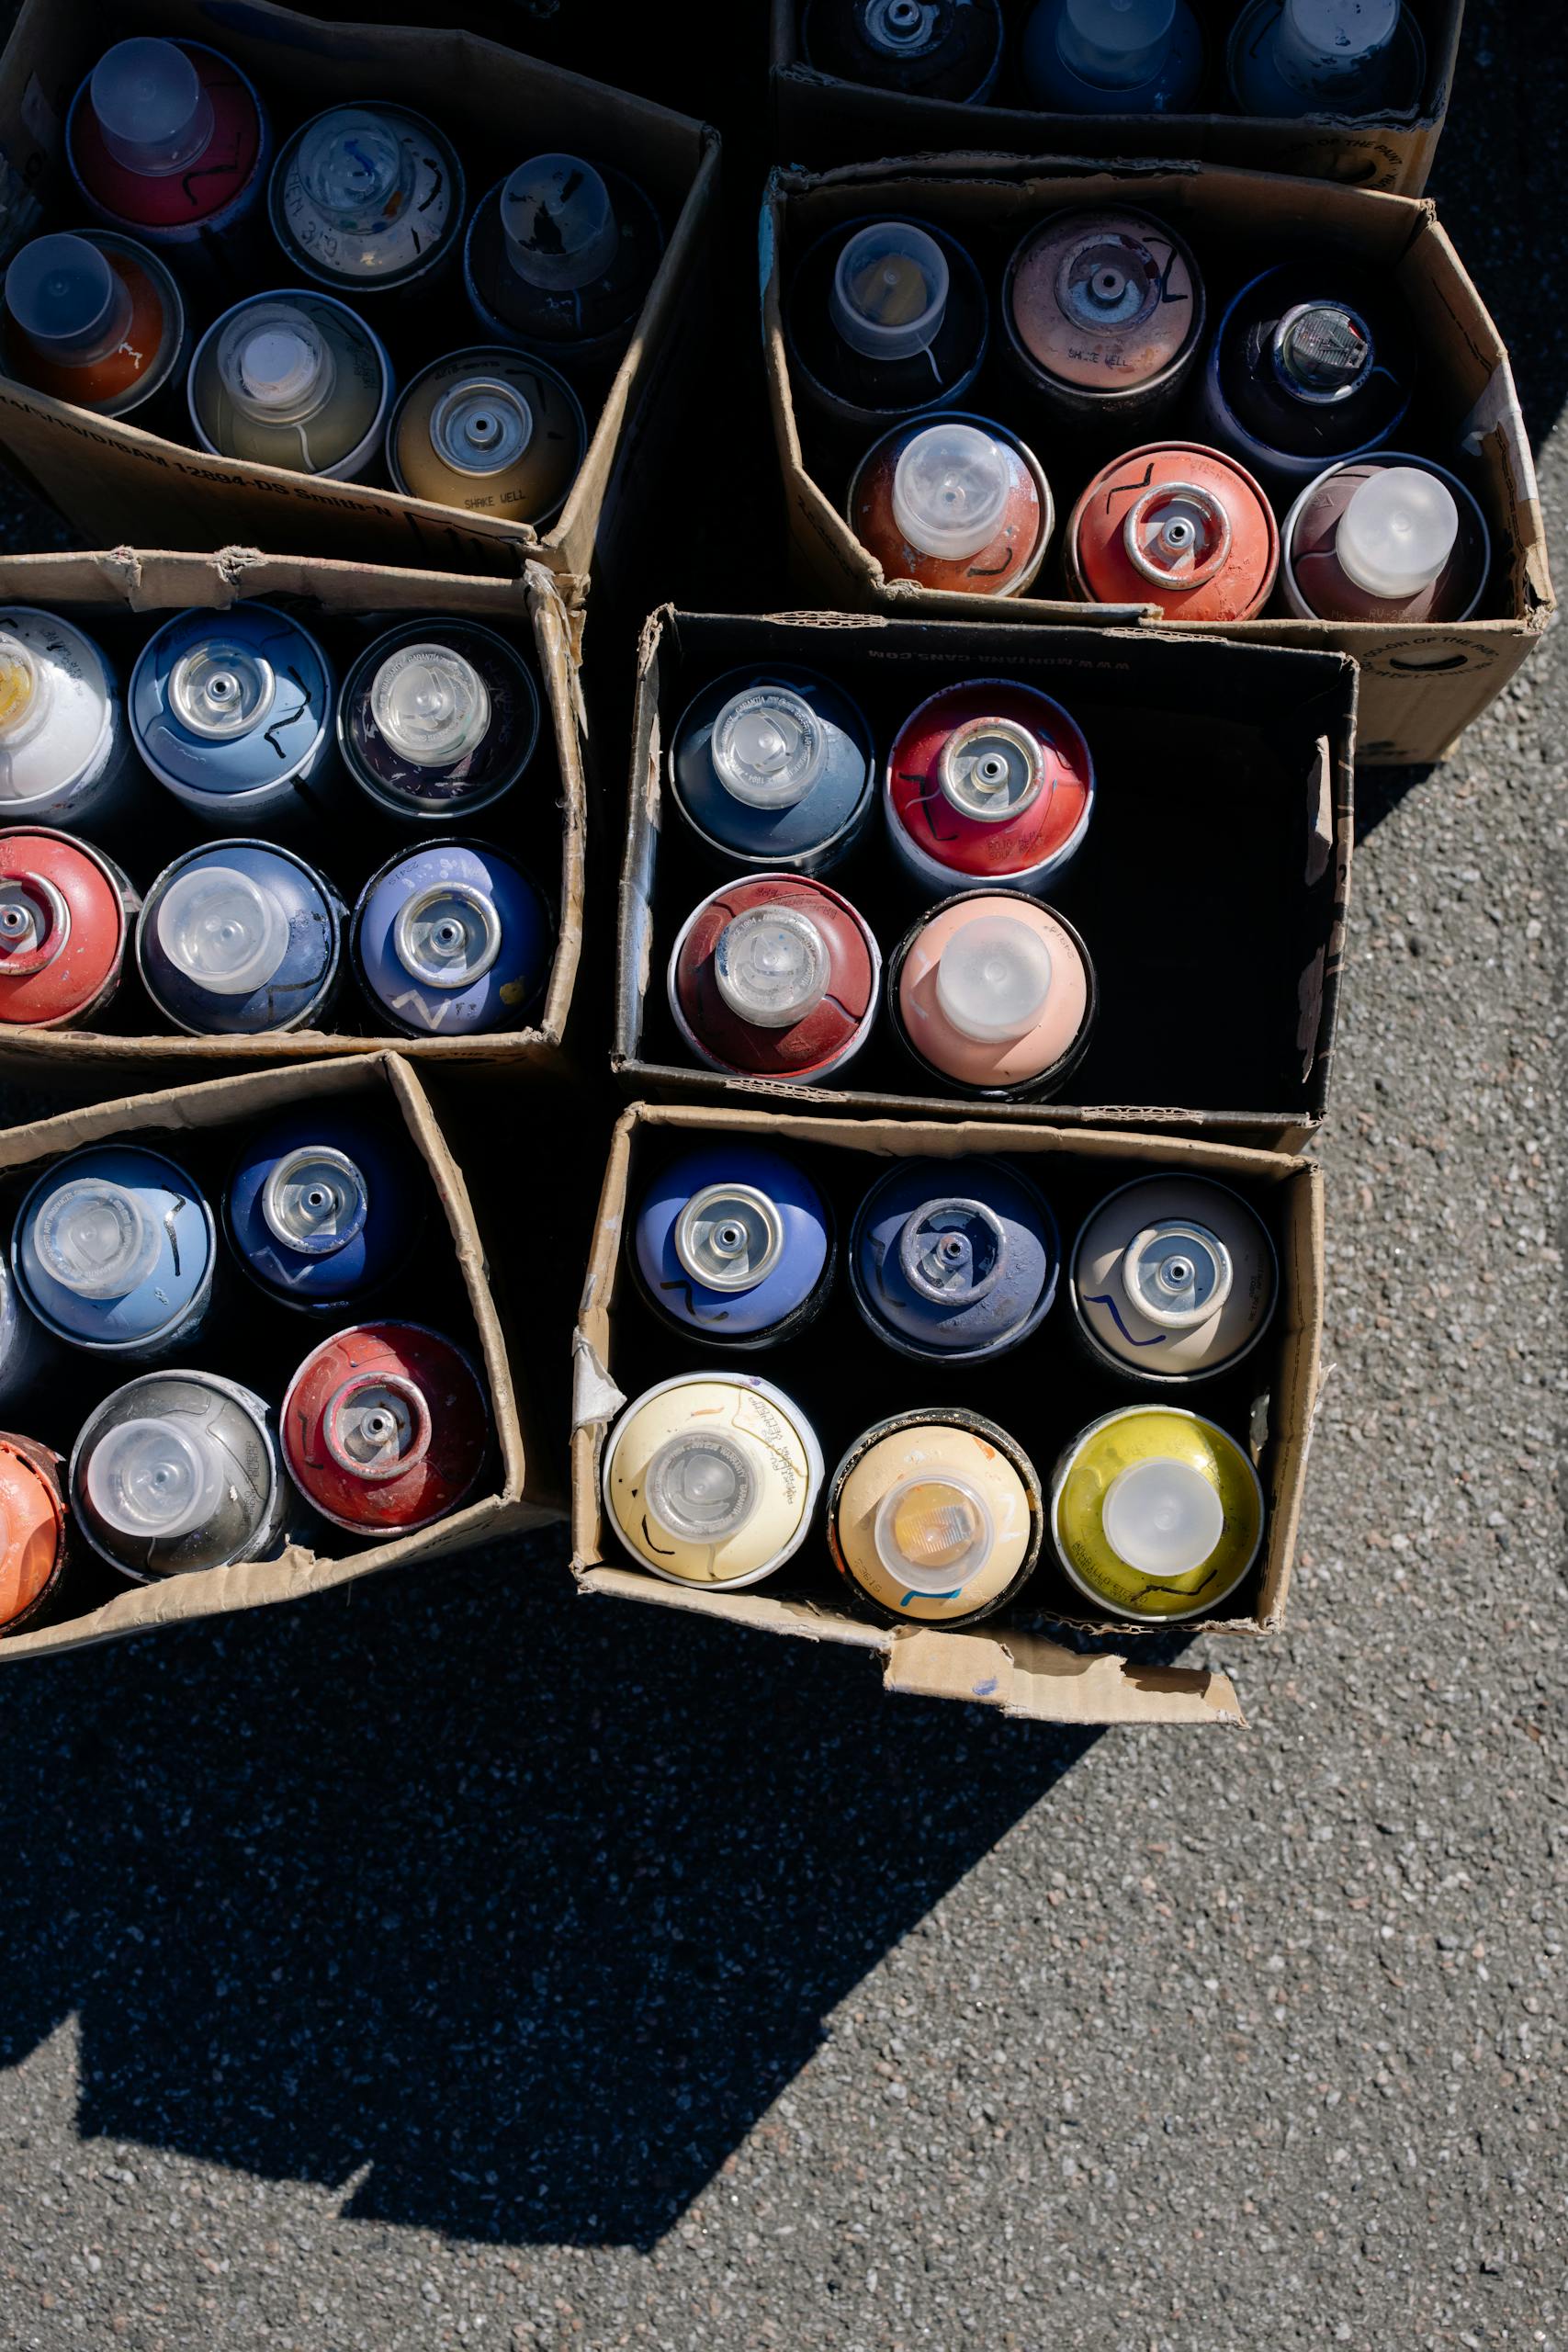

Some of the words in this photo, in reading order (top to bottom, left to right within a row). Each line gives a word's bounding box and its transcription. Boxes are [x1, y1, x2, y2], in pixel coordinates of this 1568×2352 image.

[464, 495, 494, 509] SHAKE
[500, 489, 526, 504] WELL
[1363, 640, 1412, 658] COLOR
[1441, 637, 1472, 647] THE
